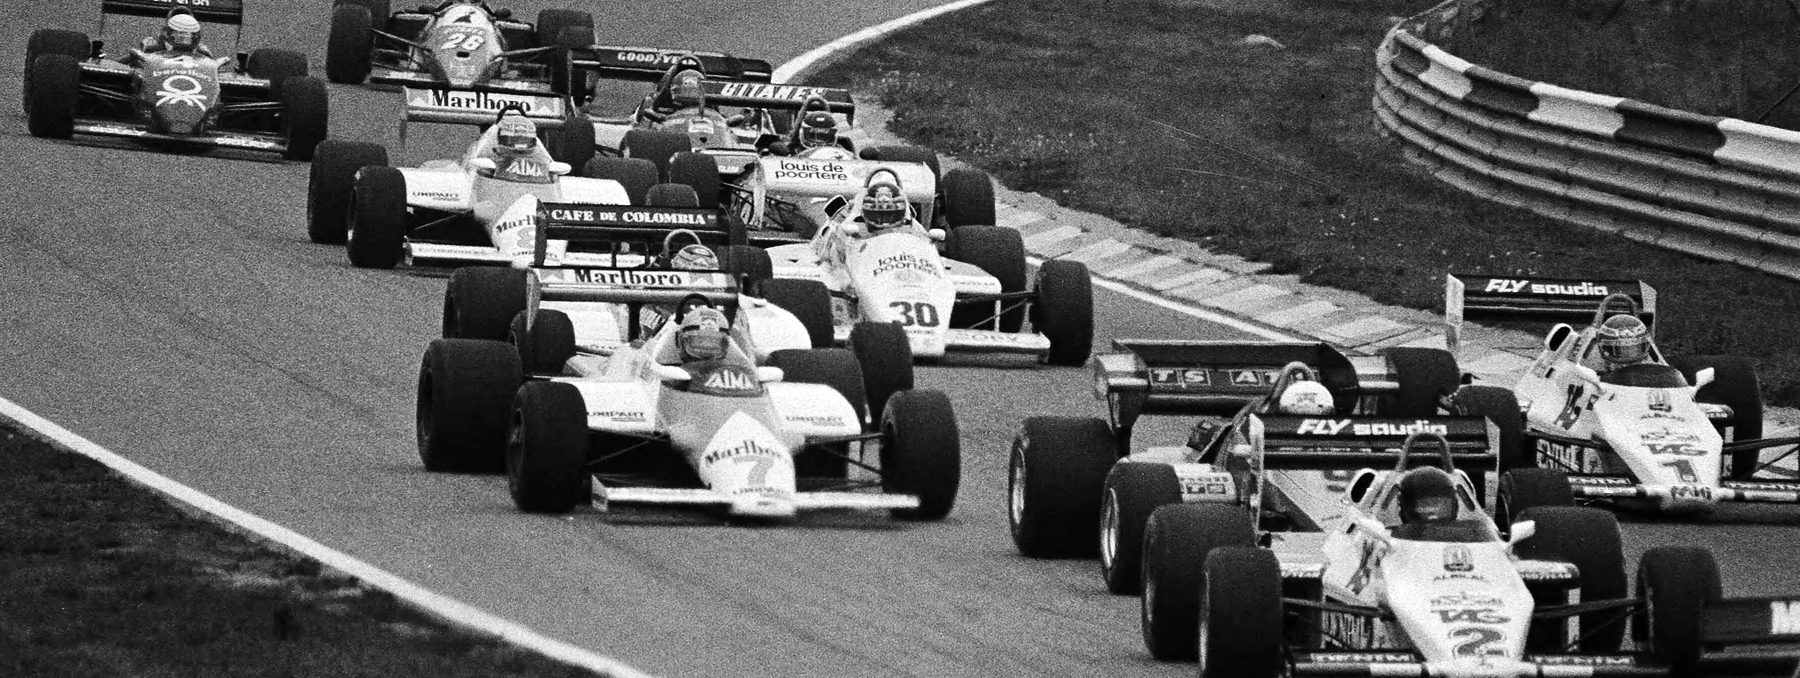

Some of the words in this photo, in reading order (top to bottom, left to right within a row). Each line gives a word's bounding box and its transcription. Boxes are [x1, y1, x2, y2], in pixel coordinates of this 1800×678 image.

[441, 33, 484, 50] 26
[433, 88, 531, 112] Marlboro
[780, 160, 819, 172] louis
[822, 162, 844, 173] de
[551, 210, 595, 222] CAFE
[599, 212, 617, 222] DE
[878, 254, 916, 267] louis
[574, 269, 682, 286] Marlboro
[1484, 278, 1530, 293] FLY
[1531, 281, 1609, 296] saudia
[889, 301, 940, 328] 30
[1297, 418, 1352, 436] FLY
[1353, 419, 1448, 436] saudia
[732, 452, 775, 487] 7
[1660, 459, 1700, 483] 1
[1450, 626, 1507, 656] 2
